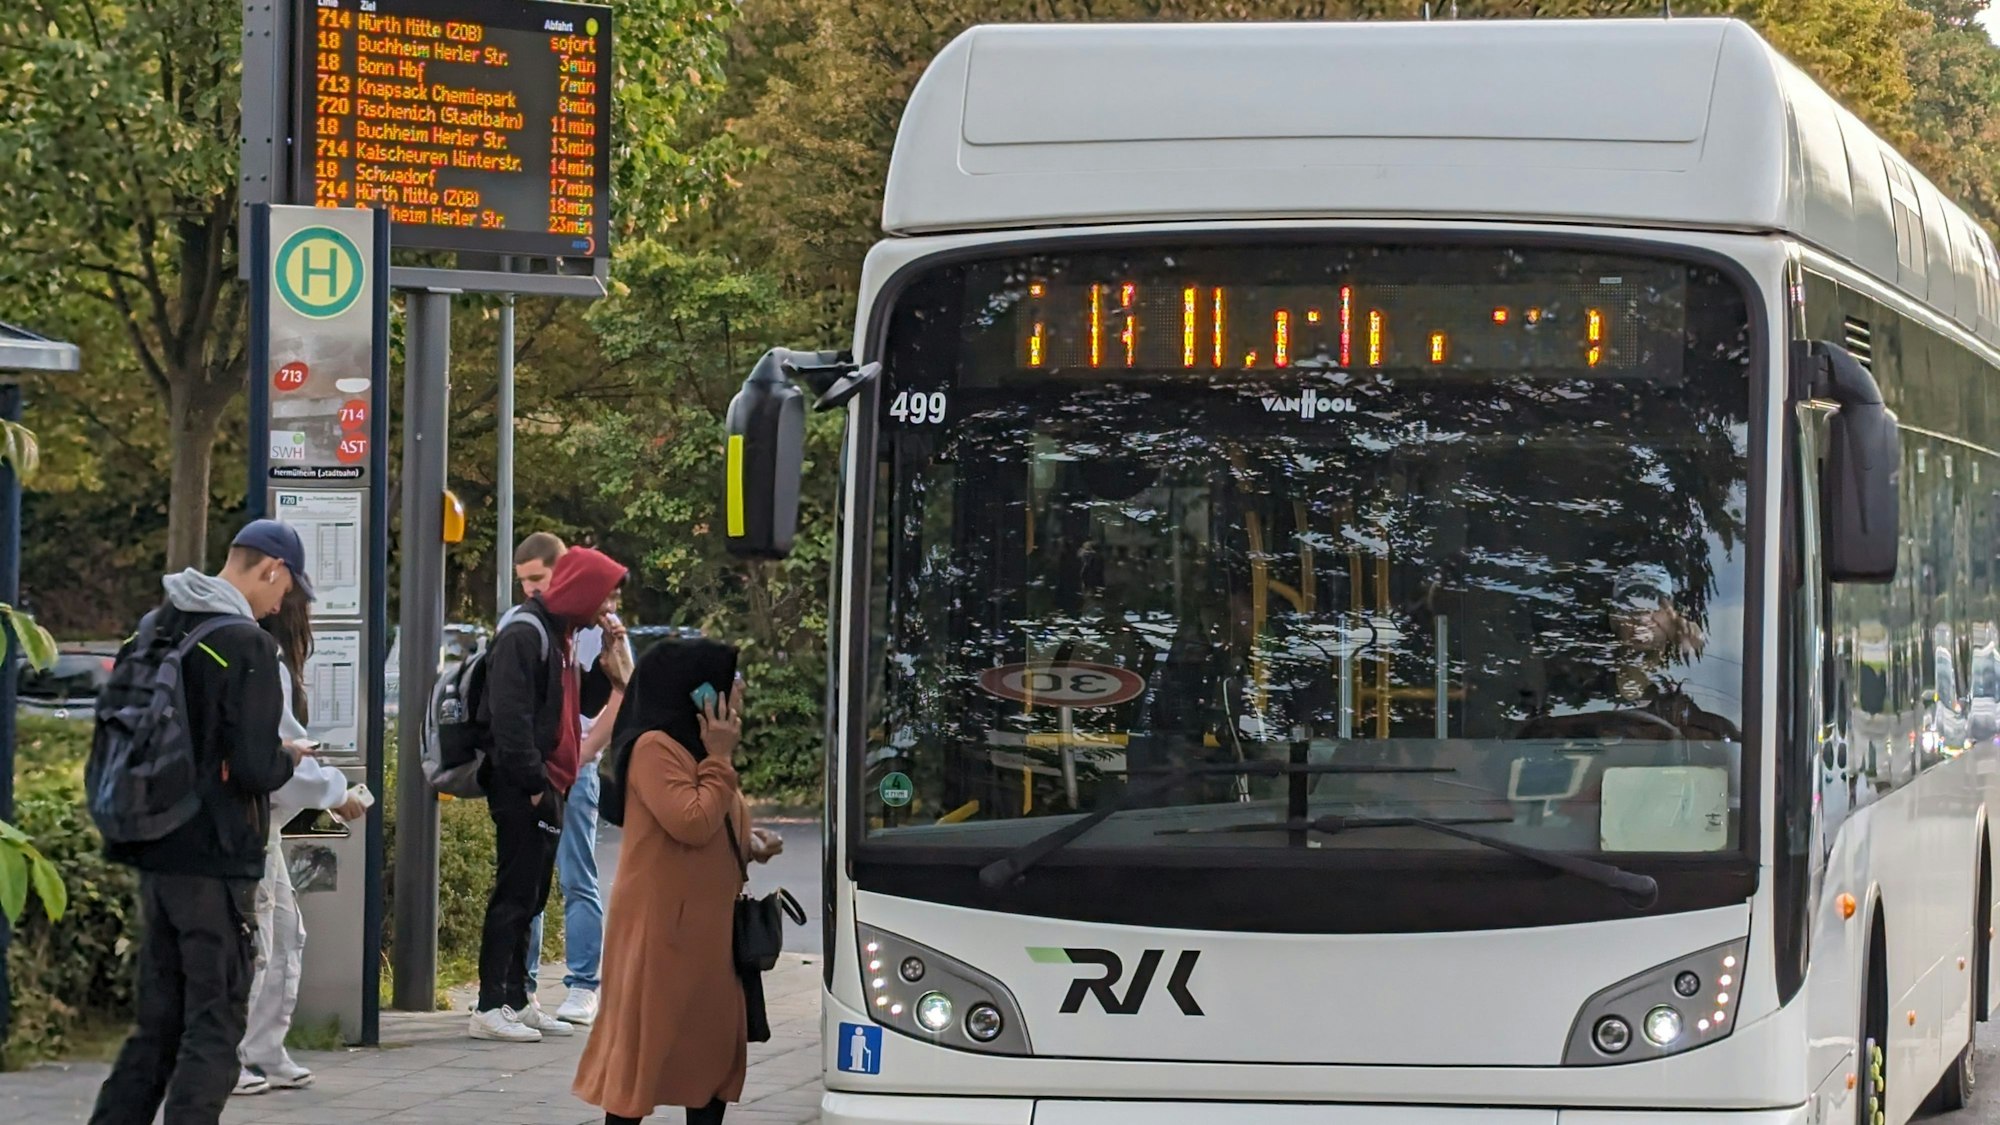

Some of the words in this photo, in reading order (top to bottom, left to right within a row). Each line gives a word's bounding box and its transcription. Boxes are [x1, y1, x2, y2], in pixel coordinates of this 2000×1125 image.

[360, 0, 376, 11] Ziel
[317, 8, 351, 29] 714
[358, 13, 401, 34] Hürth
[405, 17, 442, 38] Mitte
[446, 21, 483, 42] (ZOB)
[550, 35, 596, 55] sofort
[544, 19, 574, 32] Abfahrt
[317, 31, 341, 49] 18
[358, 35, 430, 58] Buchheim
[434, 42, 480, 63] Herler
[484, 47, 508, 66] Str.
[317, 53, 340, 71] 18
[358, 56, 395, 77] Bonn
[399, 60, 426, 83] Hbf
[317, 74, 350, 93] 713
[358, 78, 428, 101] Knapsack
[432, 85, 516, 110] Chemiepark
[317, 95, 350, 115] 720
[357, 100, 436, 122] Fischenich
[440, 105, 524, 131] (Stadtbahn)
[316, 117, 339, 135] 18
[356, 121, 429, 143] Buchheim
[432, 126, 479, 147] Herler
[483, 131, 507, 149] Str.
[316, 139, 348, 158] 714
[356, 142, 449, 165] Kalscheuren
[452, 150, 522, 172] Winterstr.
[316, 160, 338, 177] 18
[356, 163, 437, 187] Schwadorf
[316, 180, 348, 198] 714
[355, 183, 398, 202] Hürth
[403, 187, 439, 205] Mitte
[443, 189, 480, 208] (ZOB)
[431, 208, 477, 227] Herler
[481, 209, 505, 228] Str.
[302, 247, 337, 297] H
[281, 369, 302, 383] 713
[340, 408, 364, 422] 714
[890, 392, 946, 424] 499
[272, 446, 302, 459] SWH
[340, 440, 366, 454] AST
[281, 496, 296, 505] 720
[892, 775, 901, 790] 4
